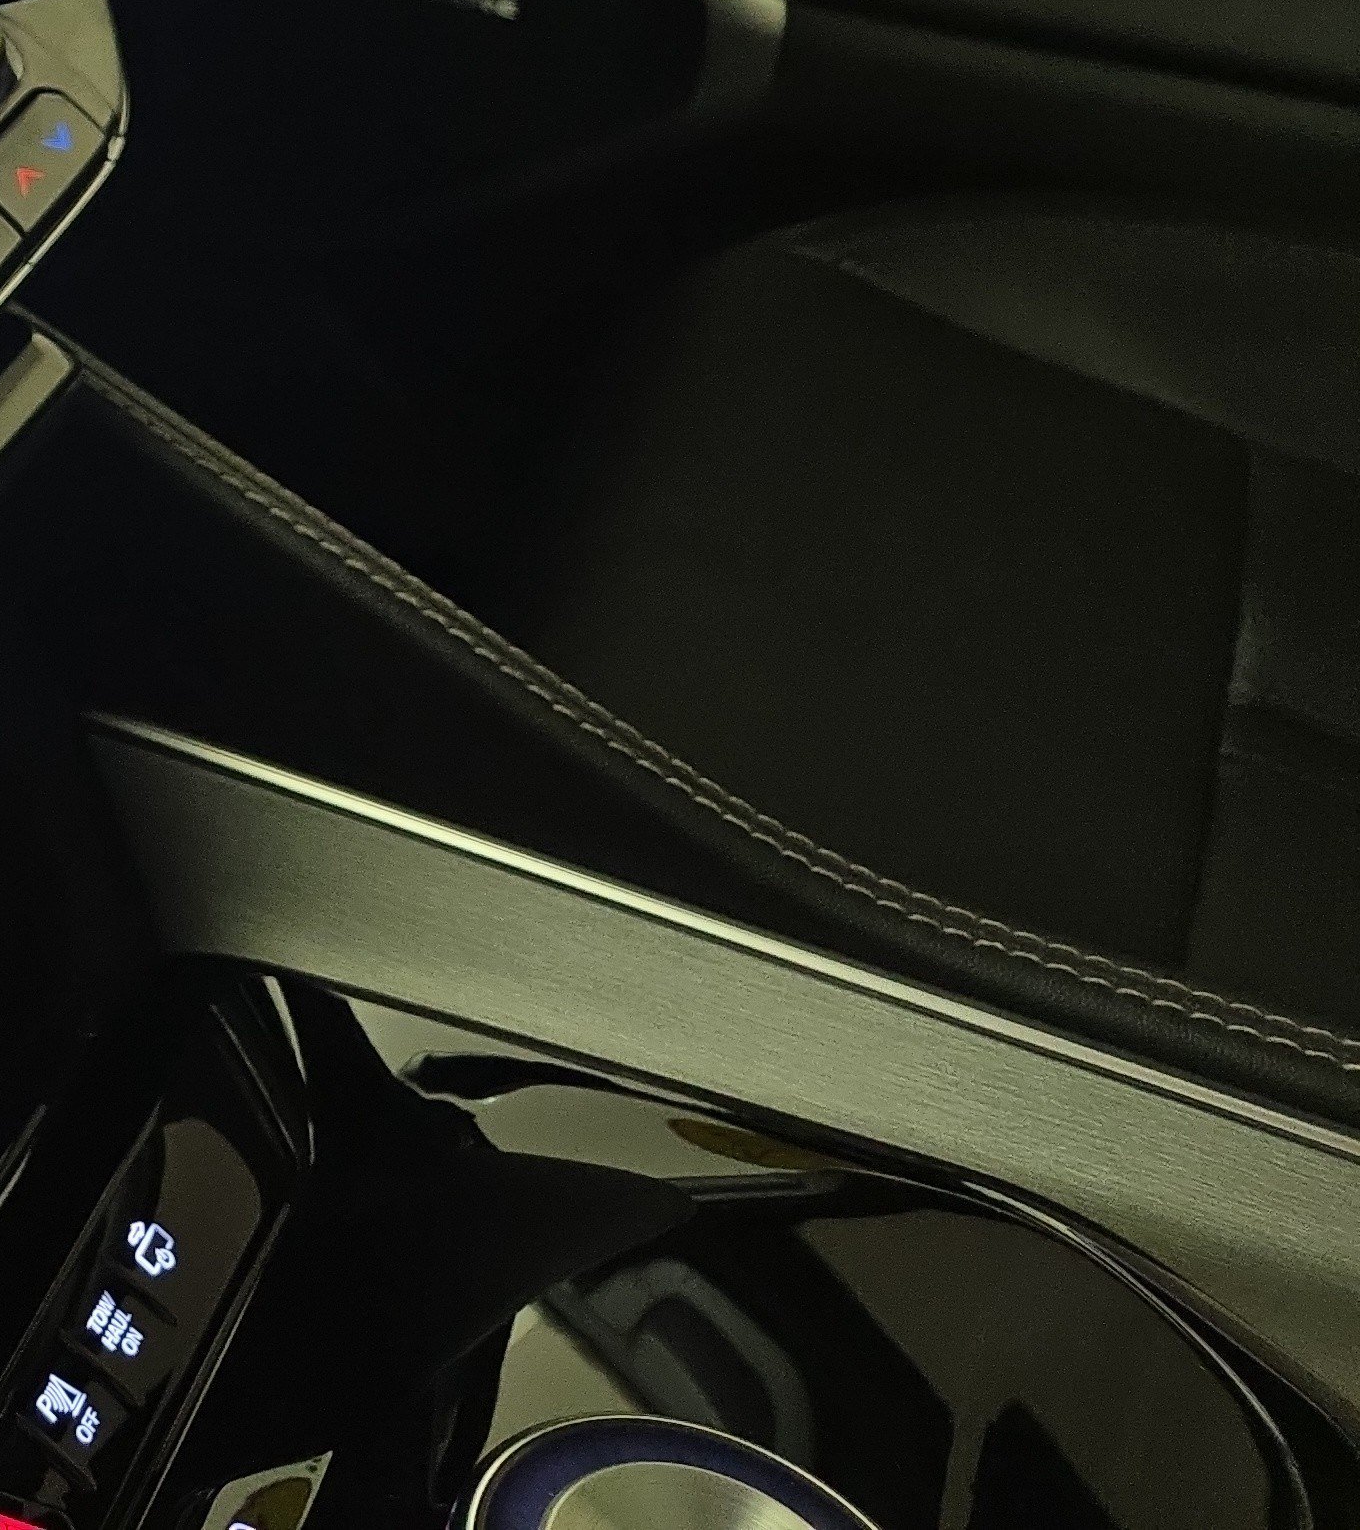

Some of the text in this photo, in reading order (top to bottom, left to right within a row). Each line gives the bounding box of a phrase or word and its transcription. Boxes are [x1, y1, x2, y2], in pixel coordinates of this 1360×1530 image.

[101, 1308, 133, 1352] HAUL
[121, 1326, 145, 1356] ON
[75, 1406, 102, 1444] OFF
